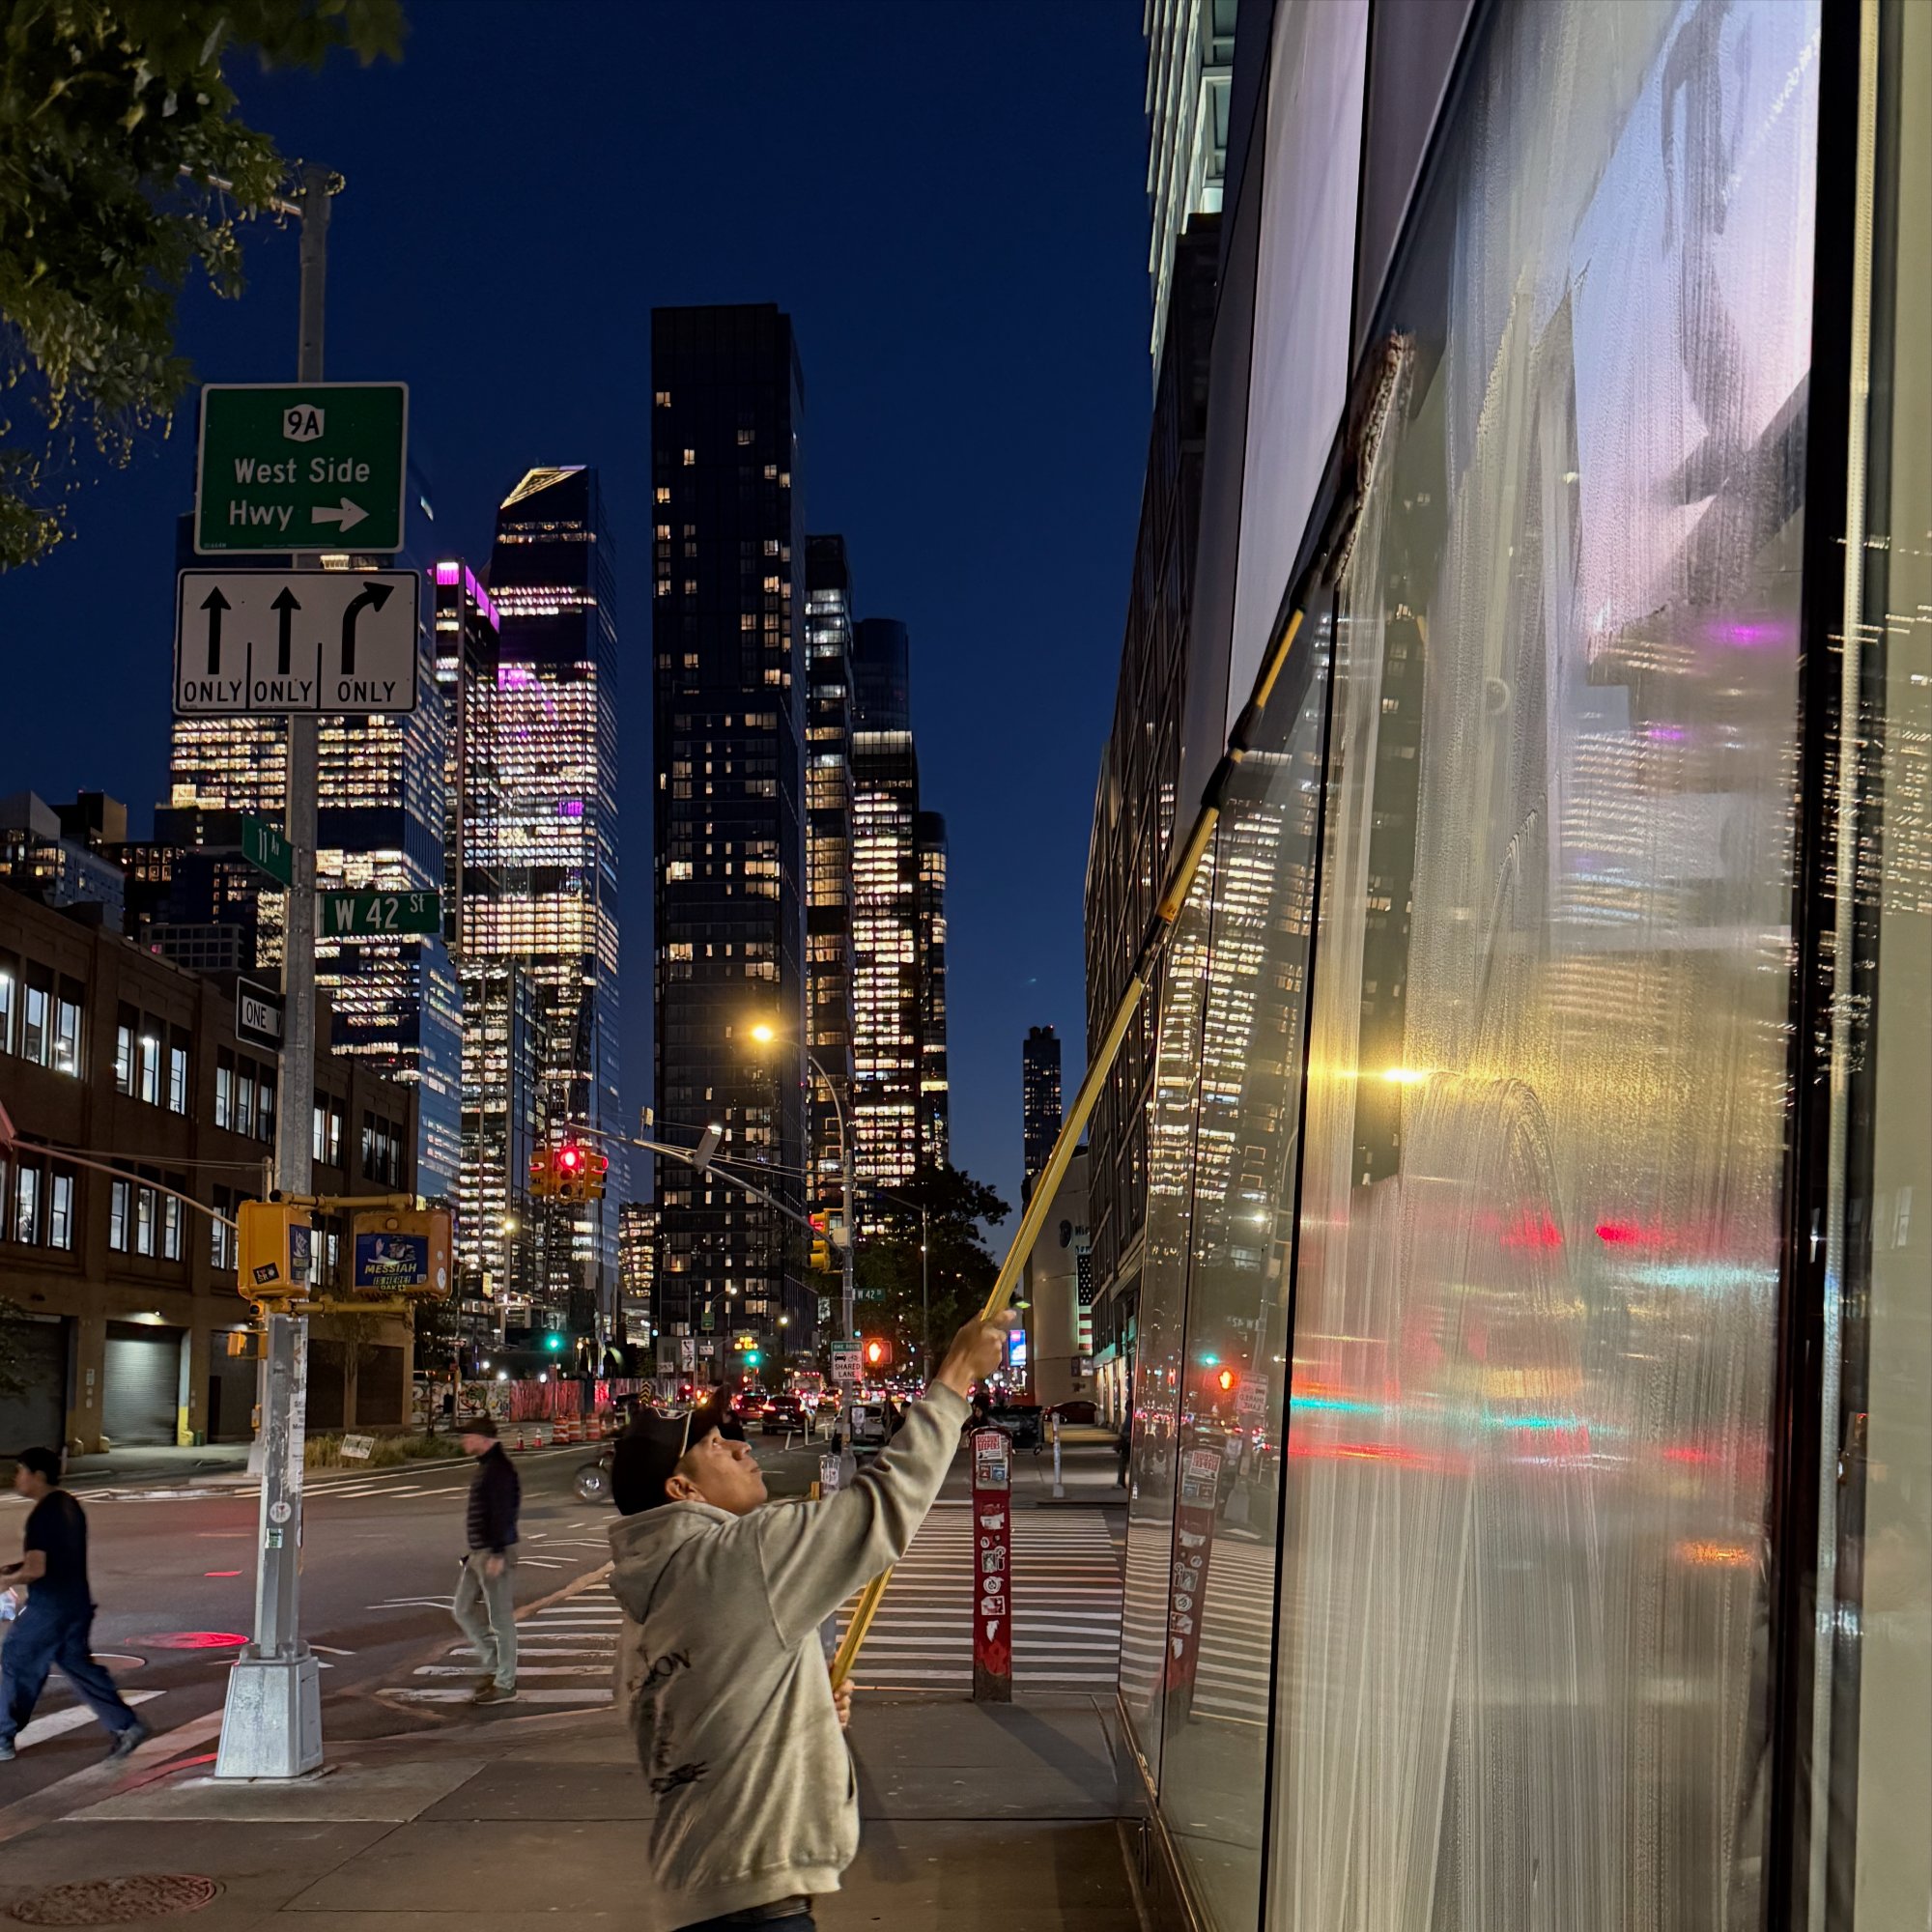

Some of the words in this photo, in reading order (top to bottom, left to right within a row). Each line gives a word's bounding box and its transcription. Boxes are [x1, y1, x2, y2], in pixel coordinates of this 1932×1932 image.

[287, 411, 320, 436] 9A
[235, 458, 297, 484] West
[308, 457, 370, 483] Side
[229, 499, 294, 531] Hwy
[184, 681, 242, 702] ONLY
[254, 681, 313, 702] ONLY
[337, 680, 396, 702] ONLY
[258, 828, 268, 864] 11
[270, 834, 280, 857] Av
[335, 899, 355, 931] W
[365, 896, 399, 929] 42
[410, 894, 424, 914] St
[246, 1001, 267, 1029] ONE
[364, 1264, 417, 1274] MESSIAH
[857, 1290, 864, 1299] W
[866, 1290, 875, 1299] 42
